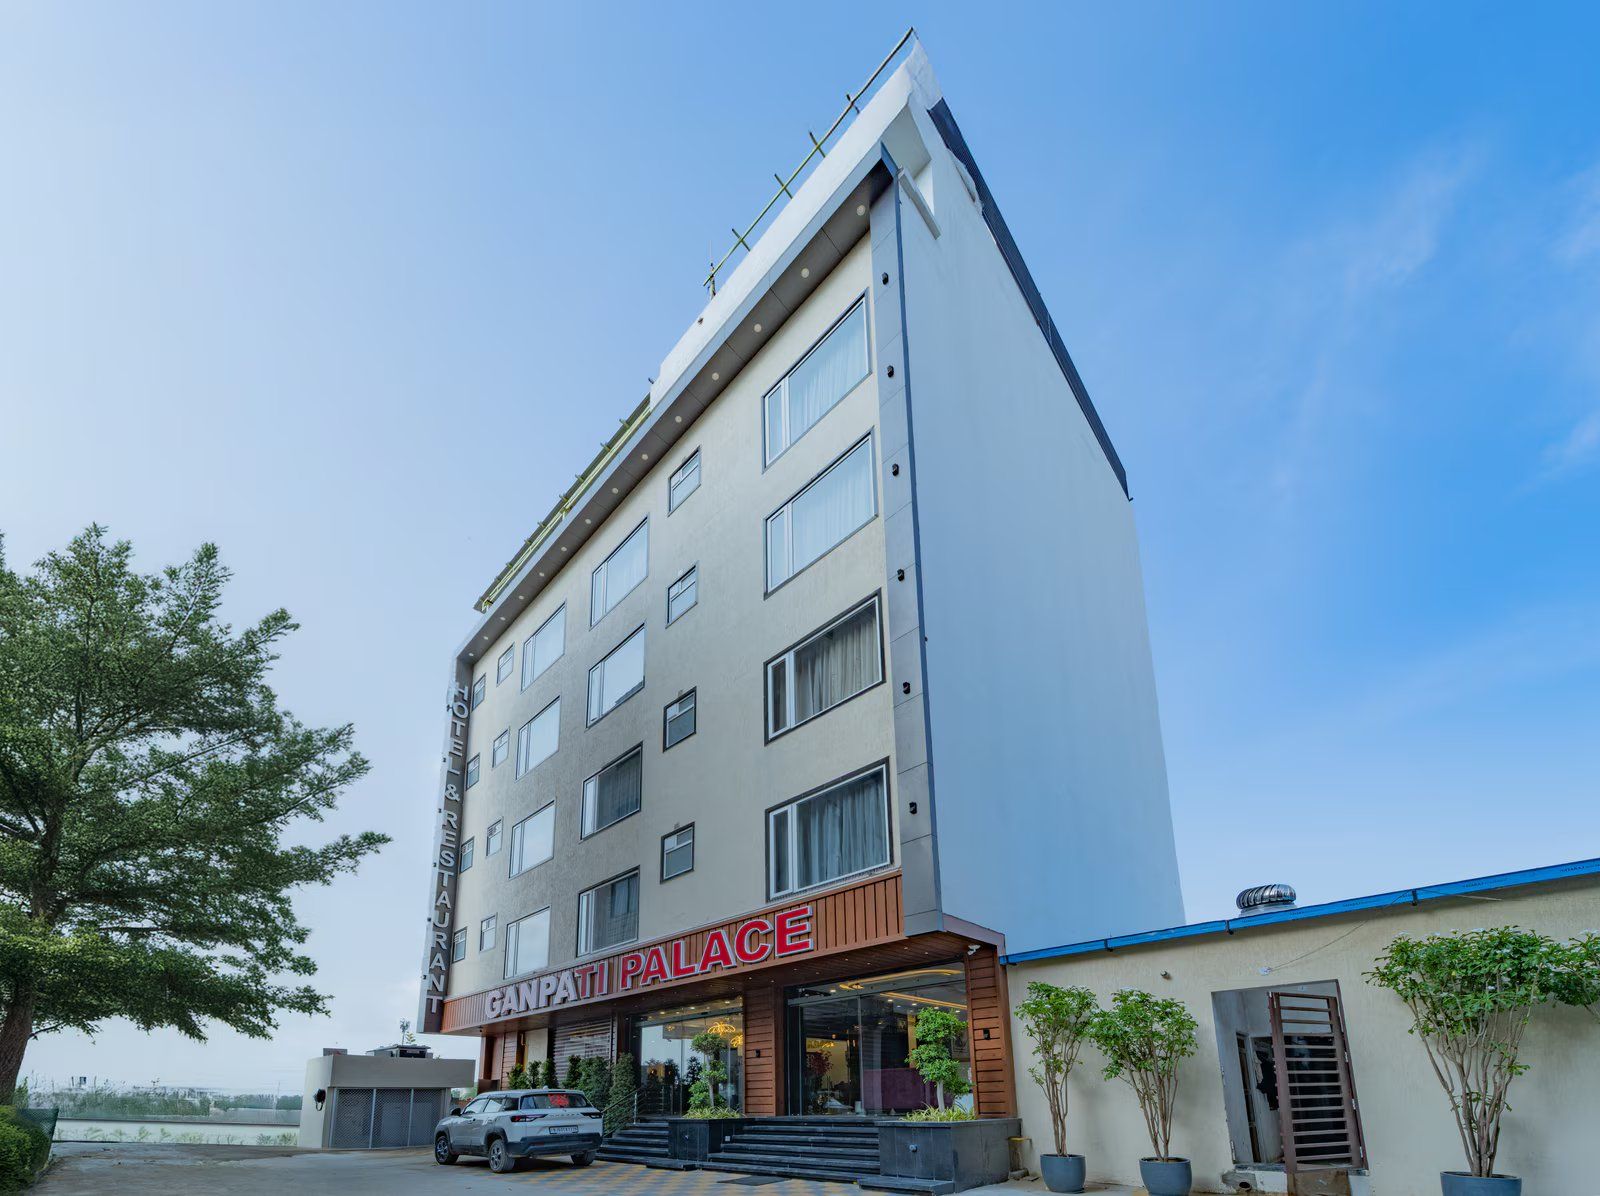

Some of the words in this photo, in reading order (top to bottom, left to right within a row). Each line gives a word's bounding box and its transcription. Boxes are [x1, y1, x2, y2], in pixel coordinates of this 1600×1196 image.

[448, 682, 469, 775] HOTEL
[444, 783, 461, 802] &
[426, 809, 458, 1014] RESTAURANT
[484, 960, 609, 1020] GANPATI
[619, 905, 815, 992] PALACE
